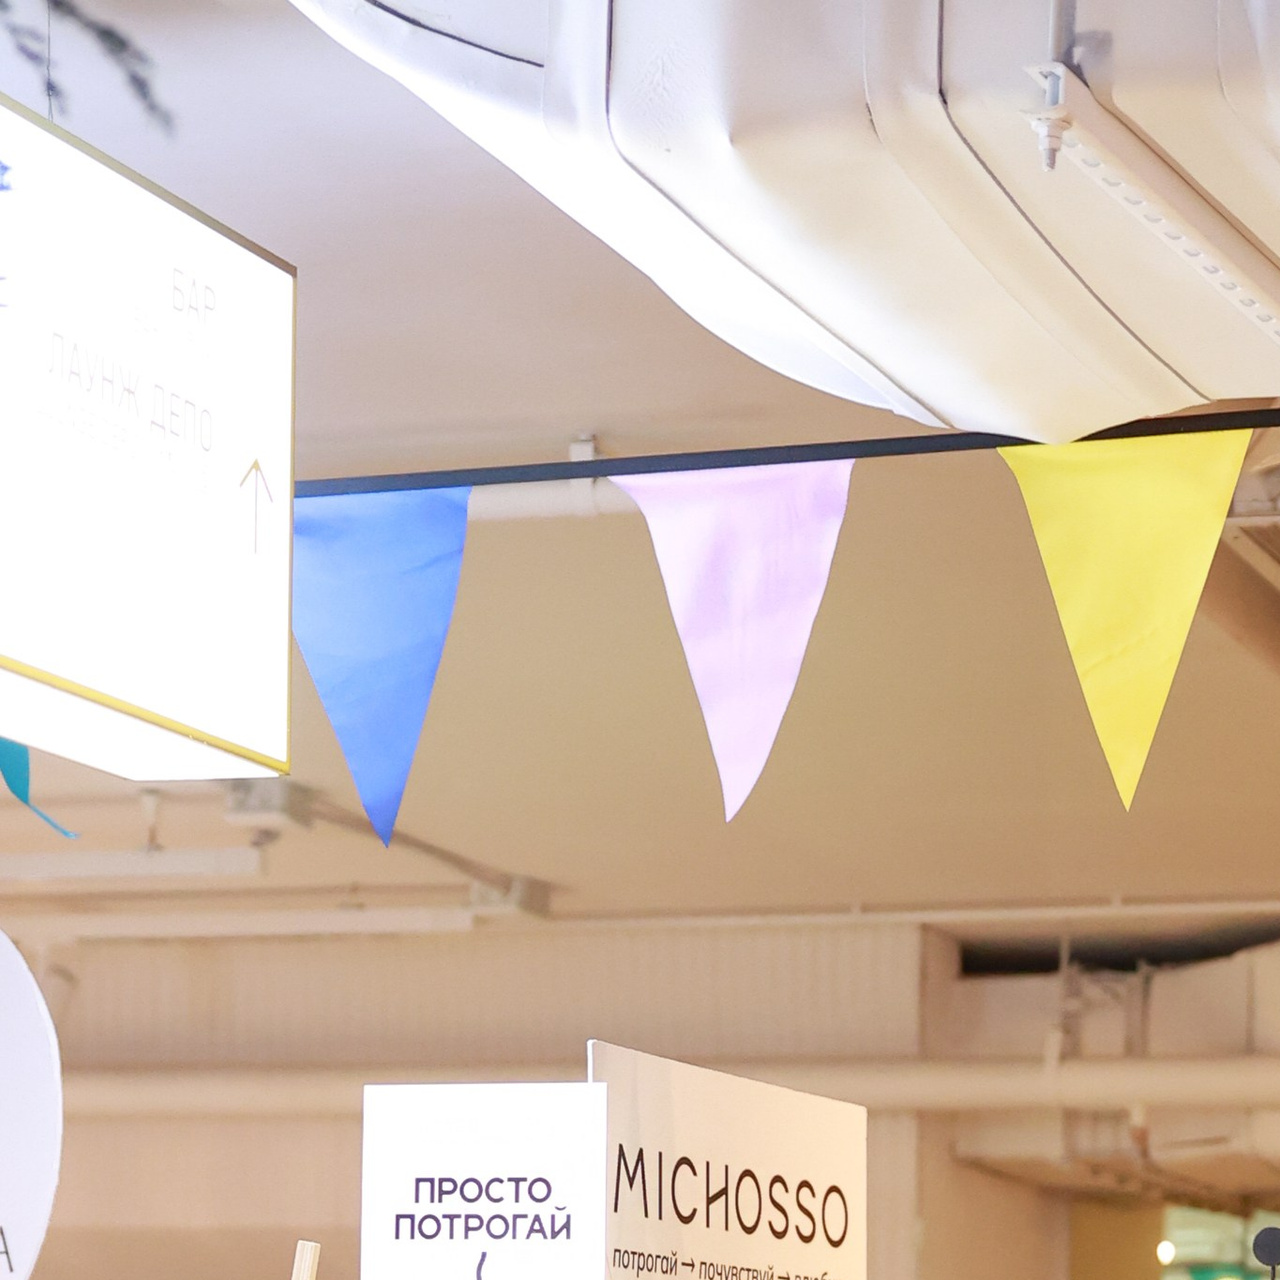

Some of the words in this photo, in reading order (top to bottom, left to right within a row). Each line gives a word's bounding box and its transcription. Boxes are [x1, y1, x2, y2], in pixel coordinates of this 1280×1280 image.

[172, 267, 217, 325] БАР
[48, 331, 140, 417] ЛАУНЖ
[149, 383, 214, 452] ДЕПО
[414, 1177, 552, 1204] ПРОСТО
[613, 1143, 849, 1249] MICHOSSO
[394, 1206, 571, 1240] ПОТРОГАЙ
[612, 1248, 678, 1278] потрогай
